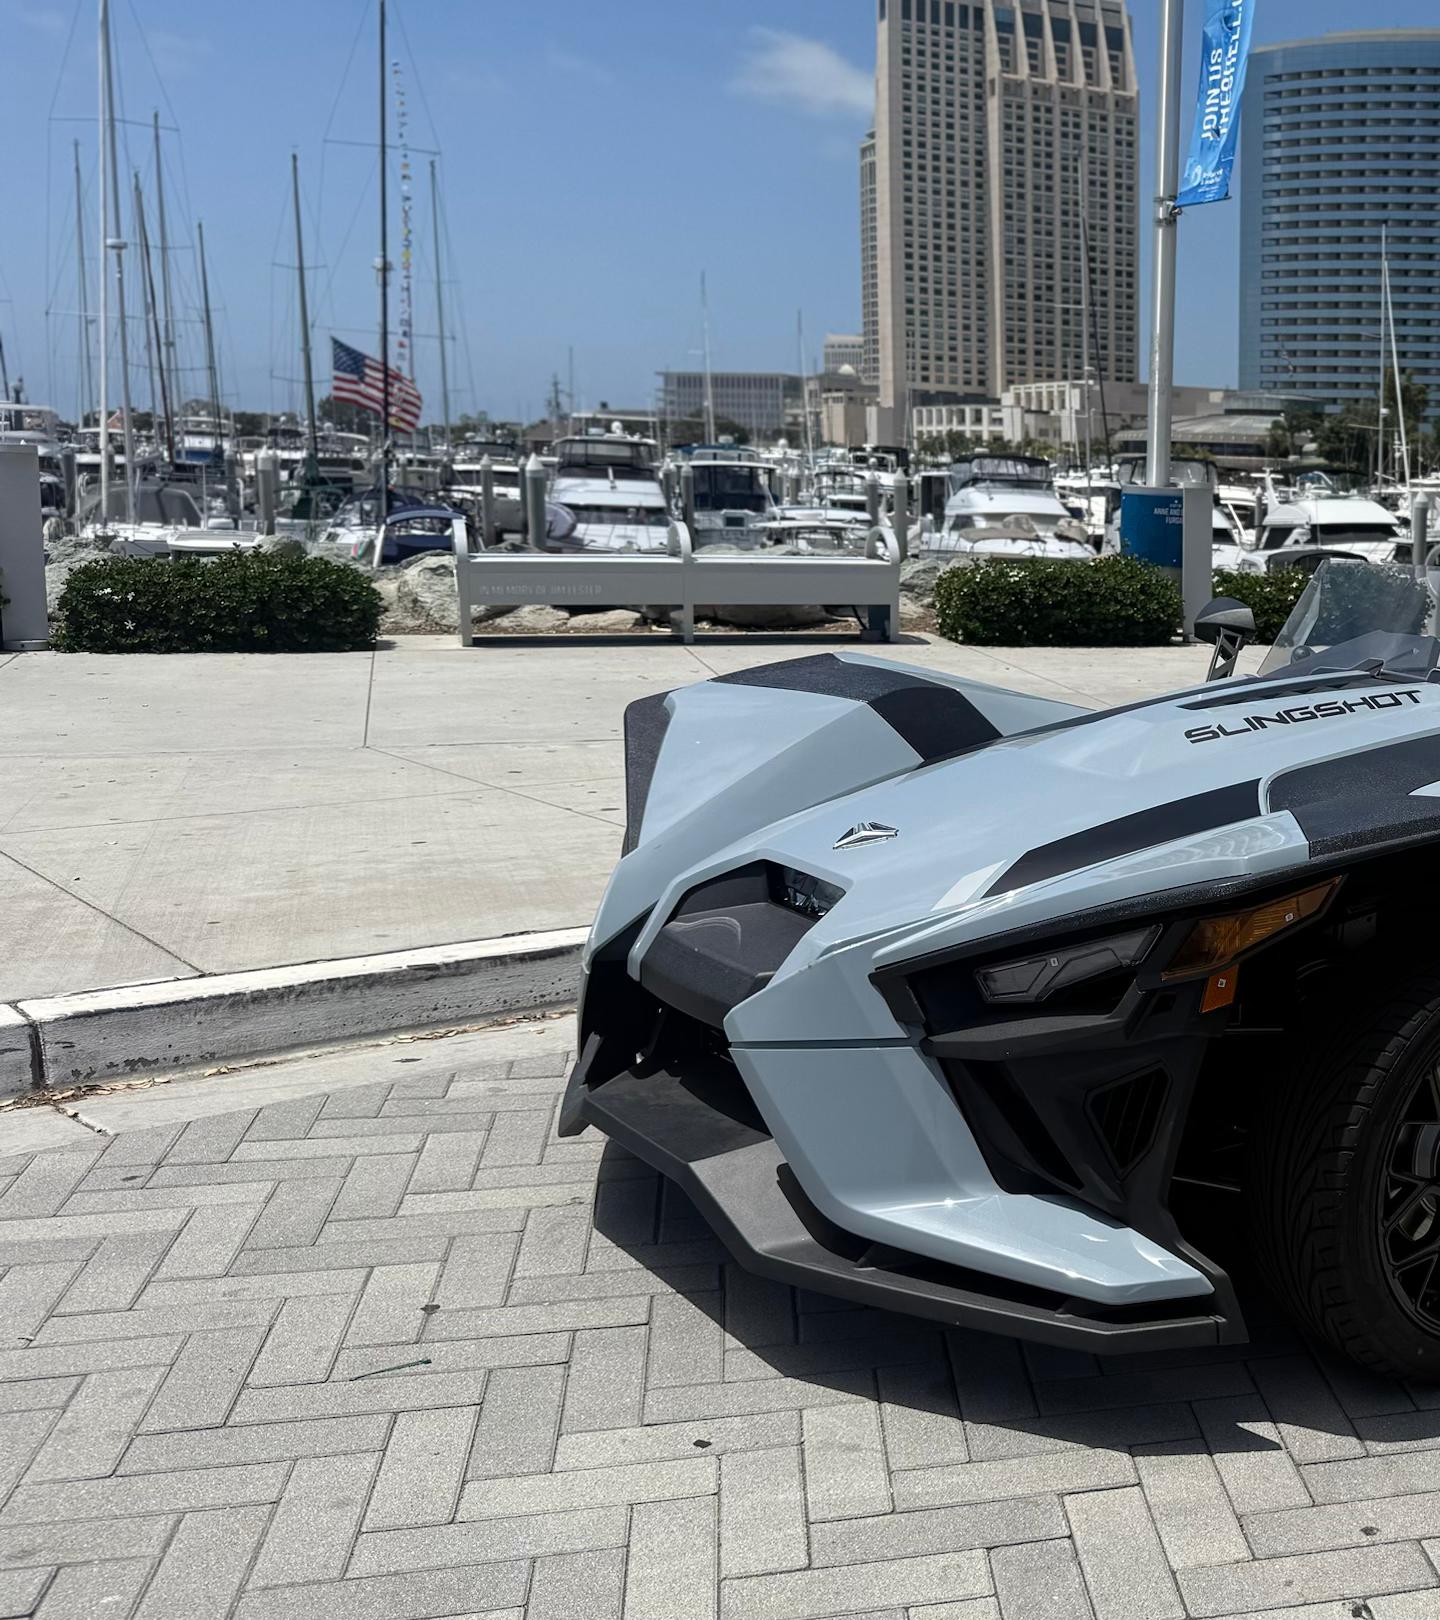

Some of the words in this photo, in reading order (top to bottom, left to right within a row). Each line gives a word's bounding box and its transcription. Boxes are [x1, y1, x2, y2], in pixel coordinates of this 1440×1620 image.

[1208, 48, 1223, 82] US
[1200, 88, 1221, 141] JOIN
[1184, 690, 1422, 744] SLINGSHOT
